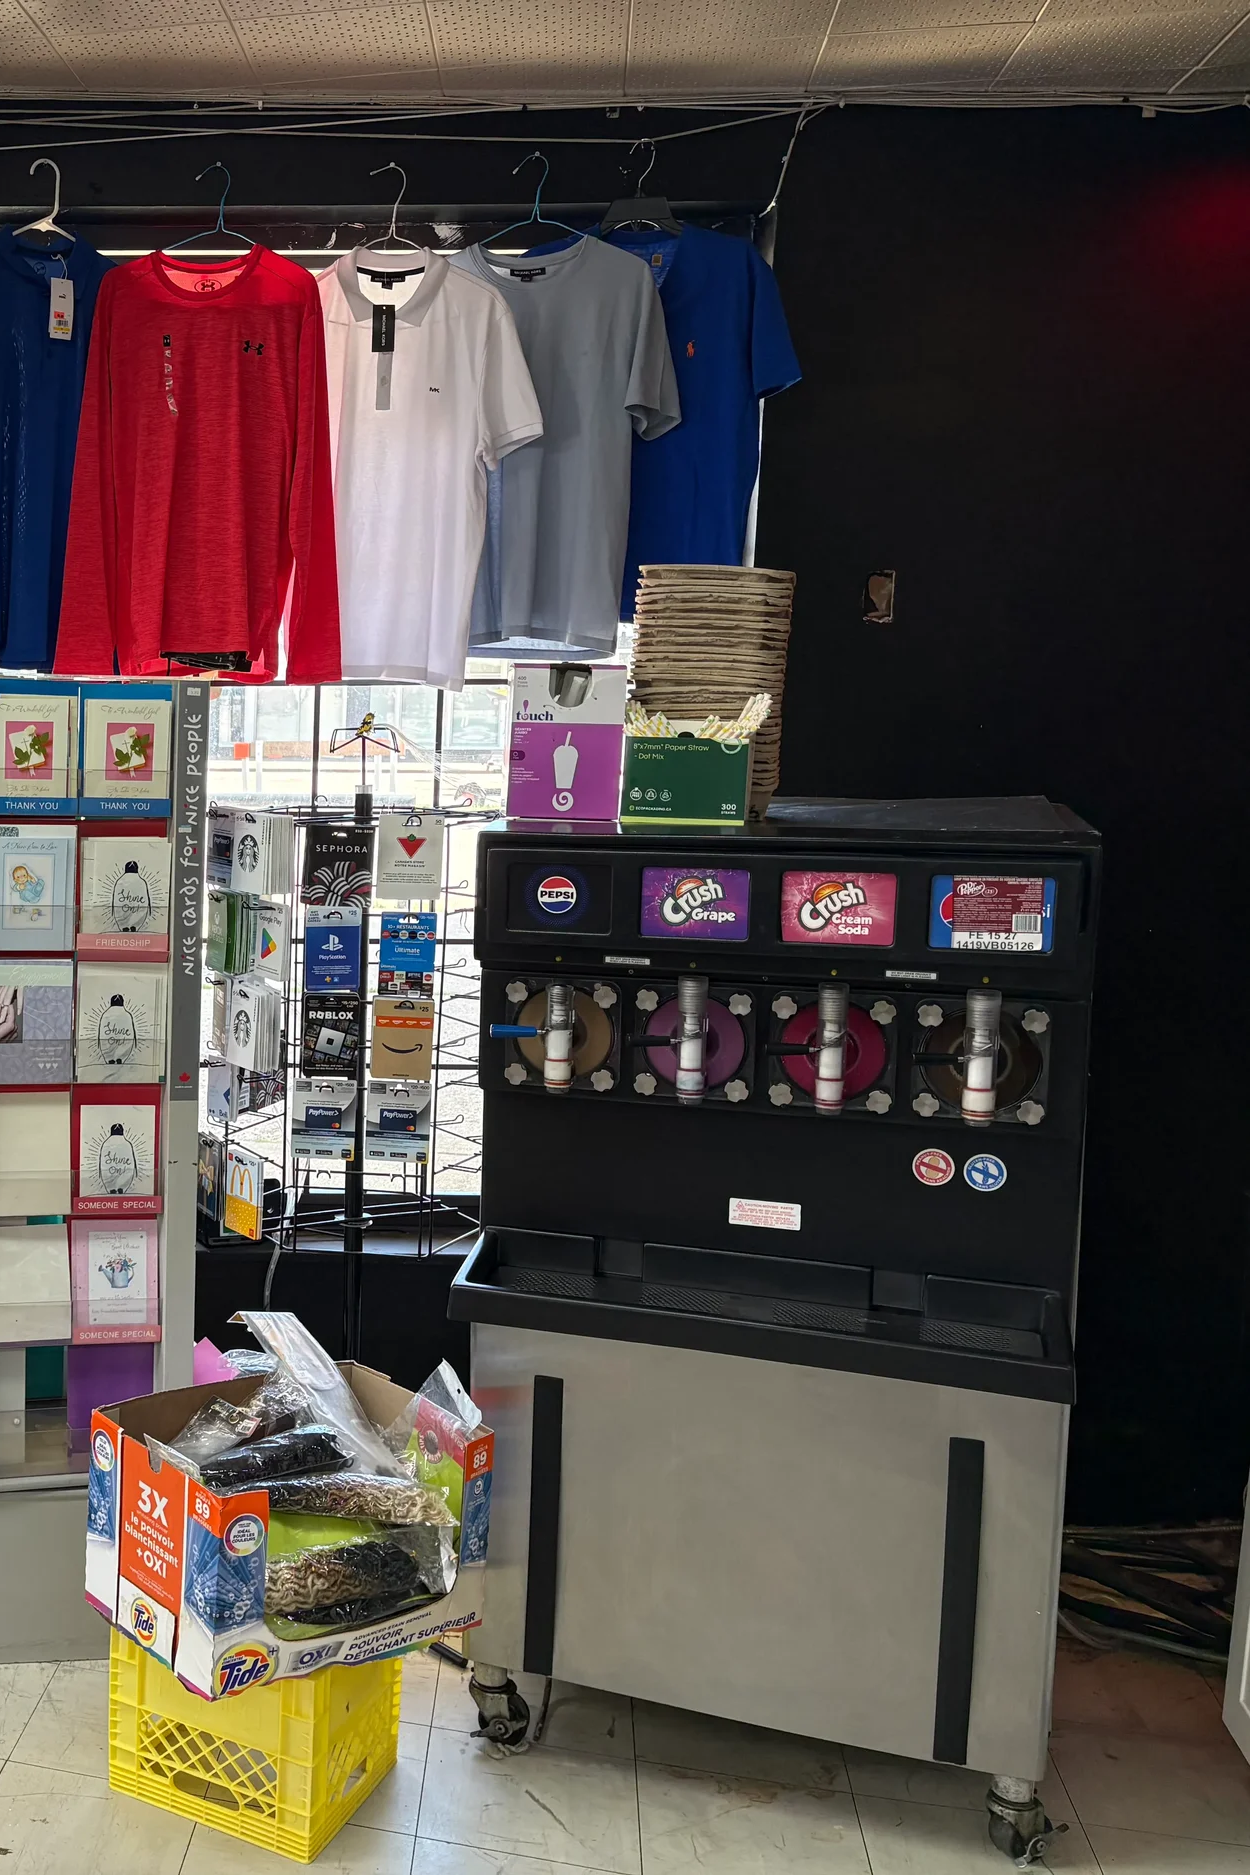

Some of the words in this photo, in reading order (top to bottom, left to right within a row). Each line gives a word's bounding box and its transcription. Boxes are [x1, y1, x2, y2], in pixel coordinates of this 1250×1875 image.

[516, 711, 554, 721] touch
[5, 801, 36, 810] THANK
[39, 801, 59, 810] YOU
[100, 801, 128, 810] THANK
[132, 802, 150, 811] YOU
[180, 835, 198, 867] for
[316, 844, 368, 854] SEPHORA
[959, 884, 984, 895] Pepper
[966, 881, 977, 889] Dr
[117, 888, 146, 904] Shine
[182, 875, 199, 927] cards
[540, 890, 574, 900] PEPSI
[662, 877, 724, 924] Crush
[801, 883, 866, 930] Crush
[258, 913, 273, 924] Google
[273, 917, 282, 927] Play
[691, 908, 736, 923] Grape
[831, 913, 872, 926] Cream
[838, 924, 869, 935] Soda
[969, 932, 983, 940] FE
[988, 932, 1001, 940] 15
[1004, 932, 1017, 940] 27
[95, 939, 150, 947] FRIENDSHIP
[394, 946, 420, 954] Ultimate
[956, 940, 1034, 950] 1419VB05126
[309, 1011, 354, 1020] ROBLOX
[104, 1022, 131, 1036] Shine
[104, 1152, 132, 1166] Shine
[123, 1201, 156, 1209] SPECIAL
[122, 1330, 155, 1338] SPECIAL
[473, 1451, 487, 1469] 89
[137, 1480, 168, 1527] 3X
[195, 1498, 210, 1519] 89
[130, 1512, 138, 1526] le
[140, 1520, 175, 1549] pouvoir
[125, 1524, 179, 1569] blanchissant
[136, 1548, 167, 1578] +OXI
[133, 1607, 154, 1635] Tide
[352, 1626, 385, 1641] ADVANCED
[385, 1621, 403, 1631] STAIN
[404, 1611, 432, 1625] REMOVAL
[344, 1633, 416, 1662] DÉTACHANT
[417, 1611, 476, 1640] SUPÉRIEUR
[348, 1628, 403, 1651] POUVOIR
[299, 1647, 332, 1665] OXI
[219, 1656, 270, 1696] Tide
